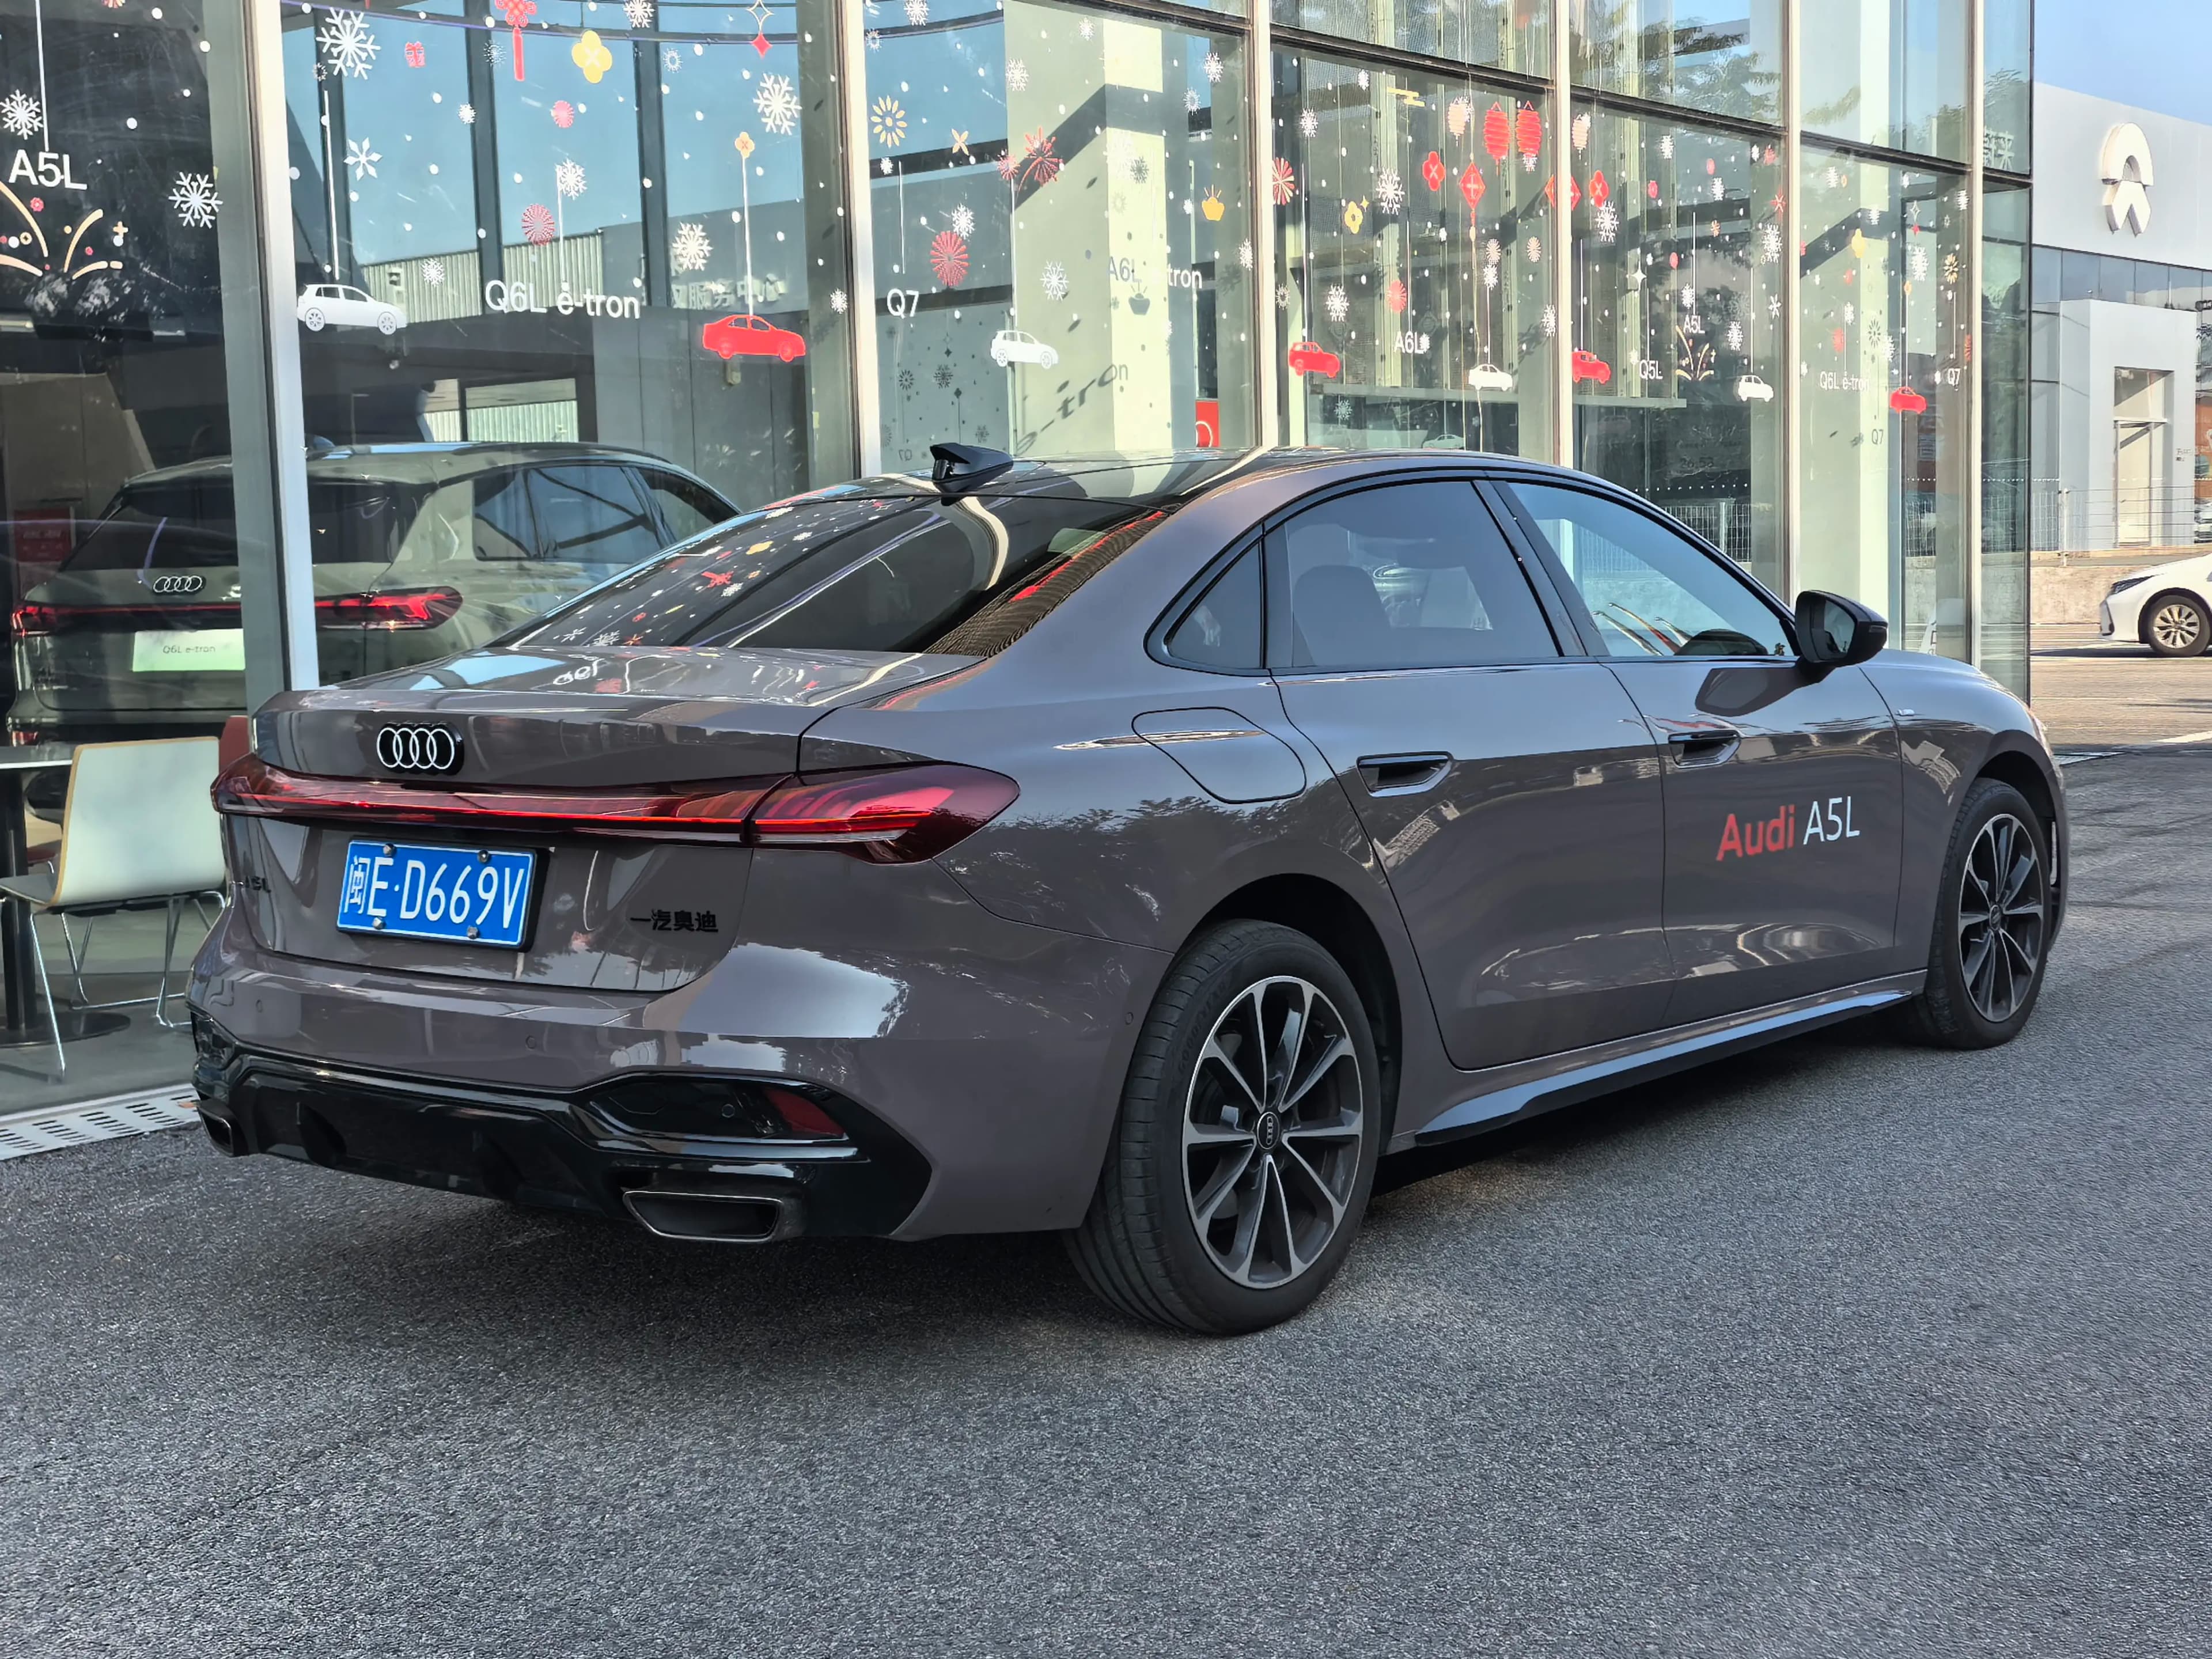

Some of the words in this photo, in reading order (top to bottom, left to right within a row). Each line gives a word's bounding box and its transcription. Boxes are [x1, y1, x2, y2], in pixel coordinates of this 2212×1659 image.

[8, 149, 88, 190] A5L
[485, 279, 548, 313] Q6L
[556, 287, 641, 319] e-tron
[887, 288, 919, 319] Q7
[1683, 314, 1706, 334] A5L
[1393, 330, 1425, 354] A6L
[1639, 359, 1664, 380] Q5L
[1820, 371, 1840, 391] Q6L
[1947, 368, 1961, 386] Q7
[1716, 804, 1796, 861] Audi
[1802, 796, 1861, 845] A5L
[630, 908, 719, 933] 一汽奥迪
